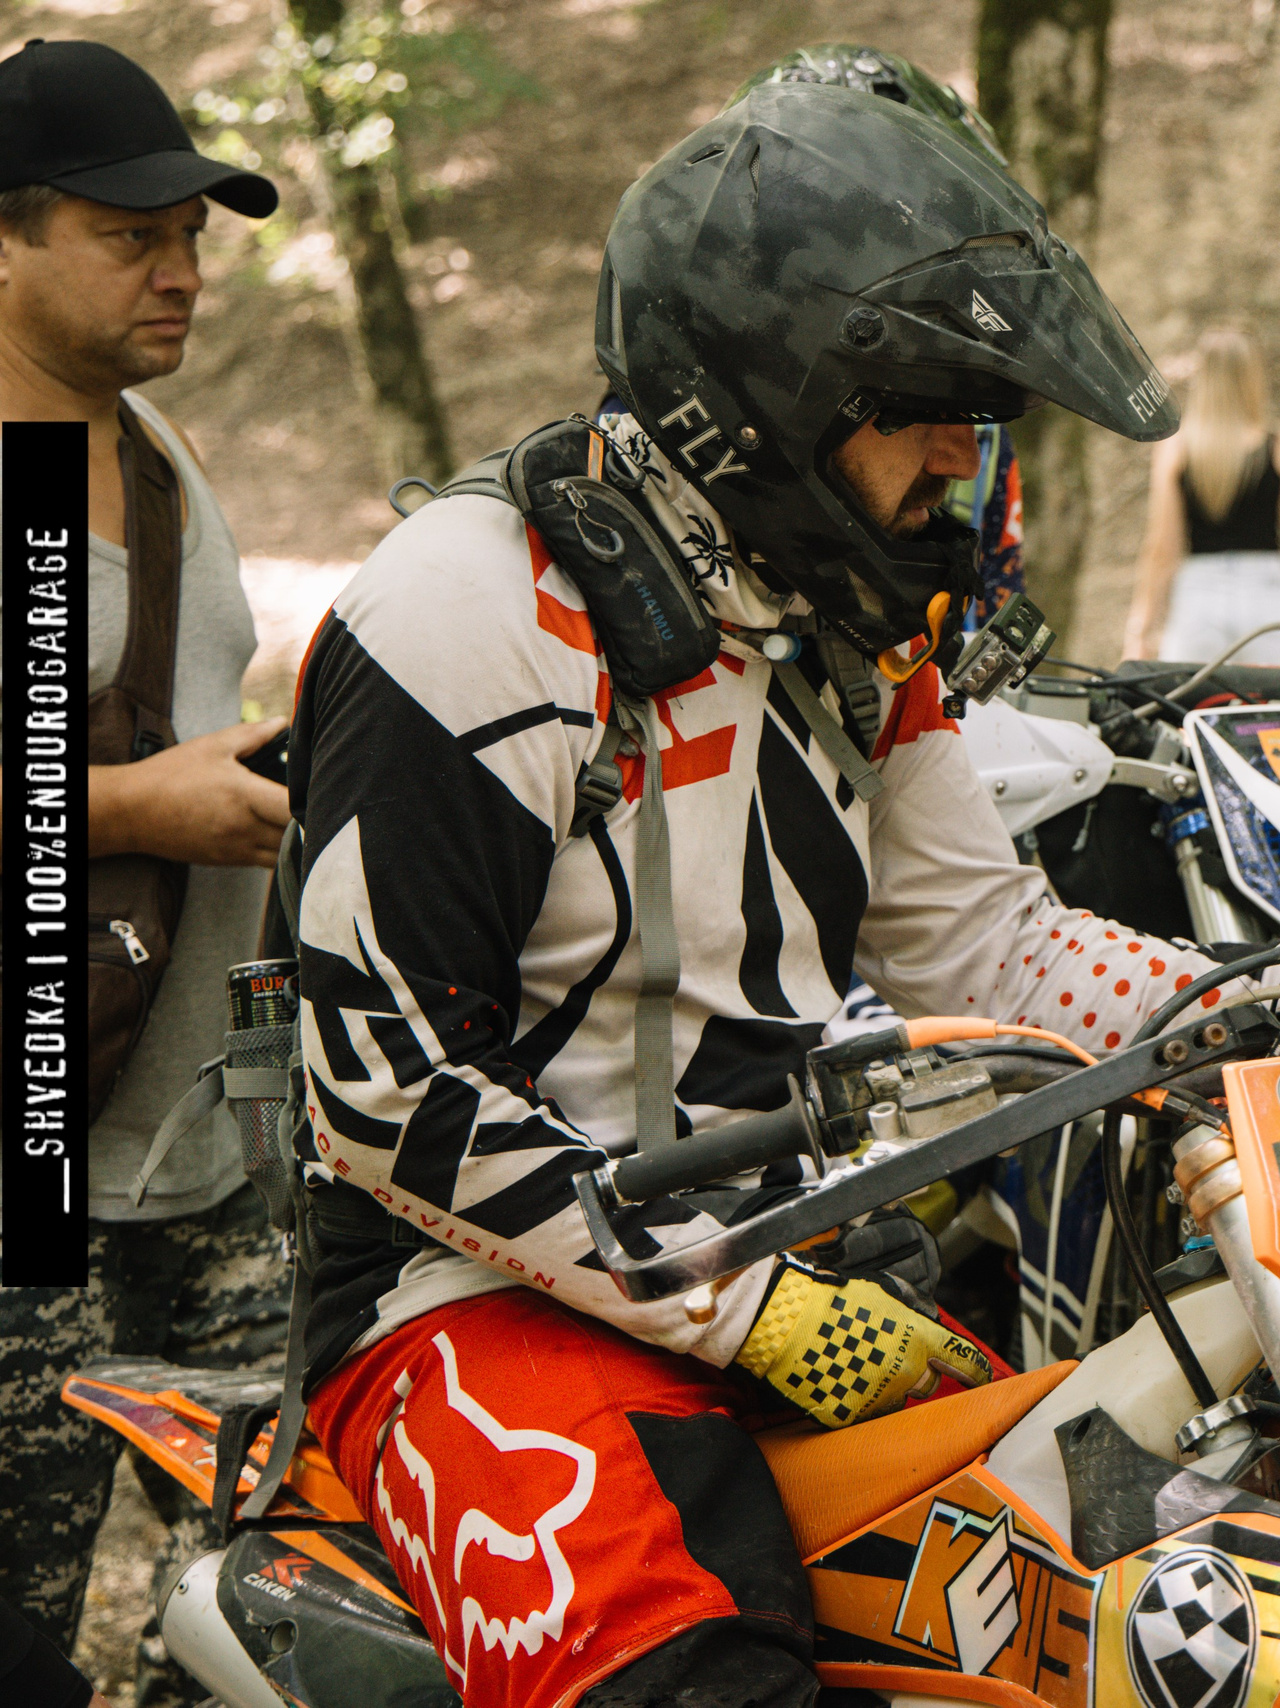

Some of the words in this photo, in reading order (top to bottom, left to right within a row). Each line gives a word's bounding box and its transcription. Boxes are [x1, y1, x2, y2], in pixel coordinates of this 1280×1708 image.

[657, 393, 751, 487] FLY
[838, 620, 874, 649] KINETIC
[250, 976, 286, 992] BUR
[372, 1186, 557, 1290] DIVISION
[860, 1375, 892, 1414] CHERISH
[888, 1355, 904, 1376] THE
[898, 1323, 915, 1354] DAYS
[242, 1572, 298, 1602] CAKEN
